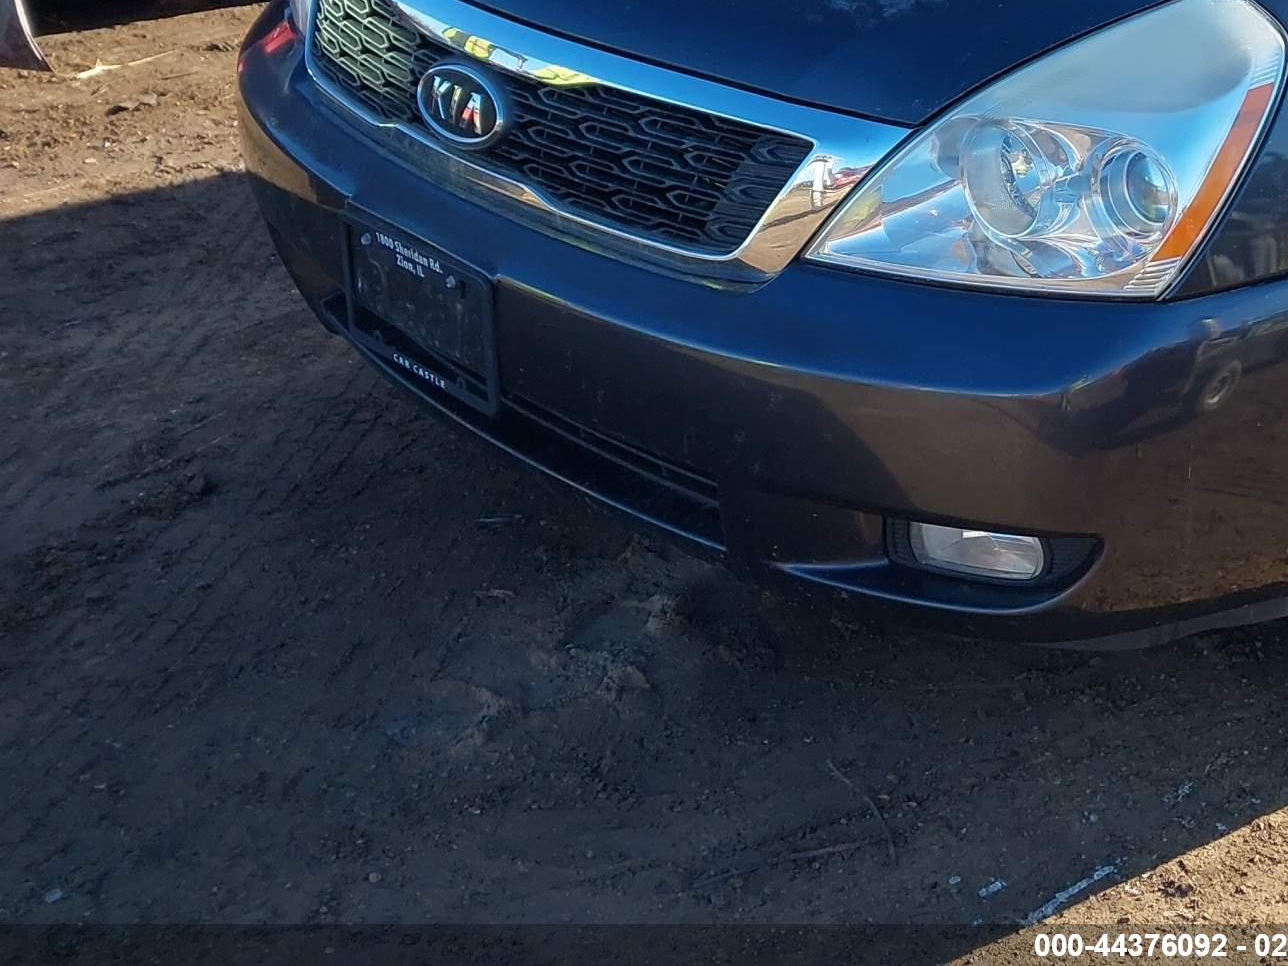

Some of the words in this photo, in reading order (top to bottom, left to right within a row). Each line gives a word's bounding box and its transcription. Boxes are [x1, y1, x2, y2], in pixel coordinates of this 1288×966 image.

[430, 75, 483, 135] KIA
[375, 232, 394, 249] 1800
[394, 240, 429, 268] Sheridan
[428, 257, 444, 274] Rd.
[395, 253, 416, 275] Zion,
[416, 264, 425, 278] IL
[393, 353, 410, 369] CAR
[413, 364, 446, 389] CASTLE
